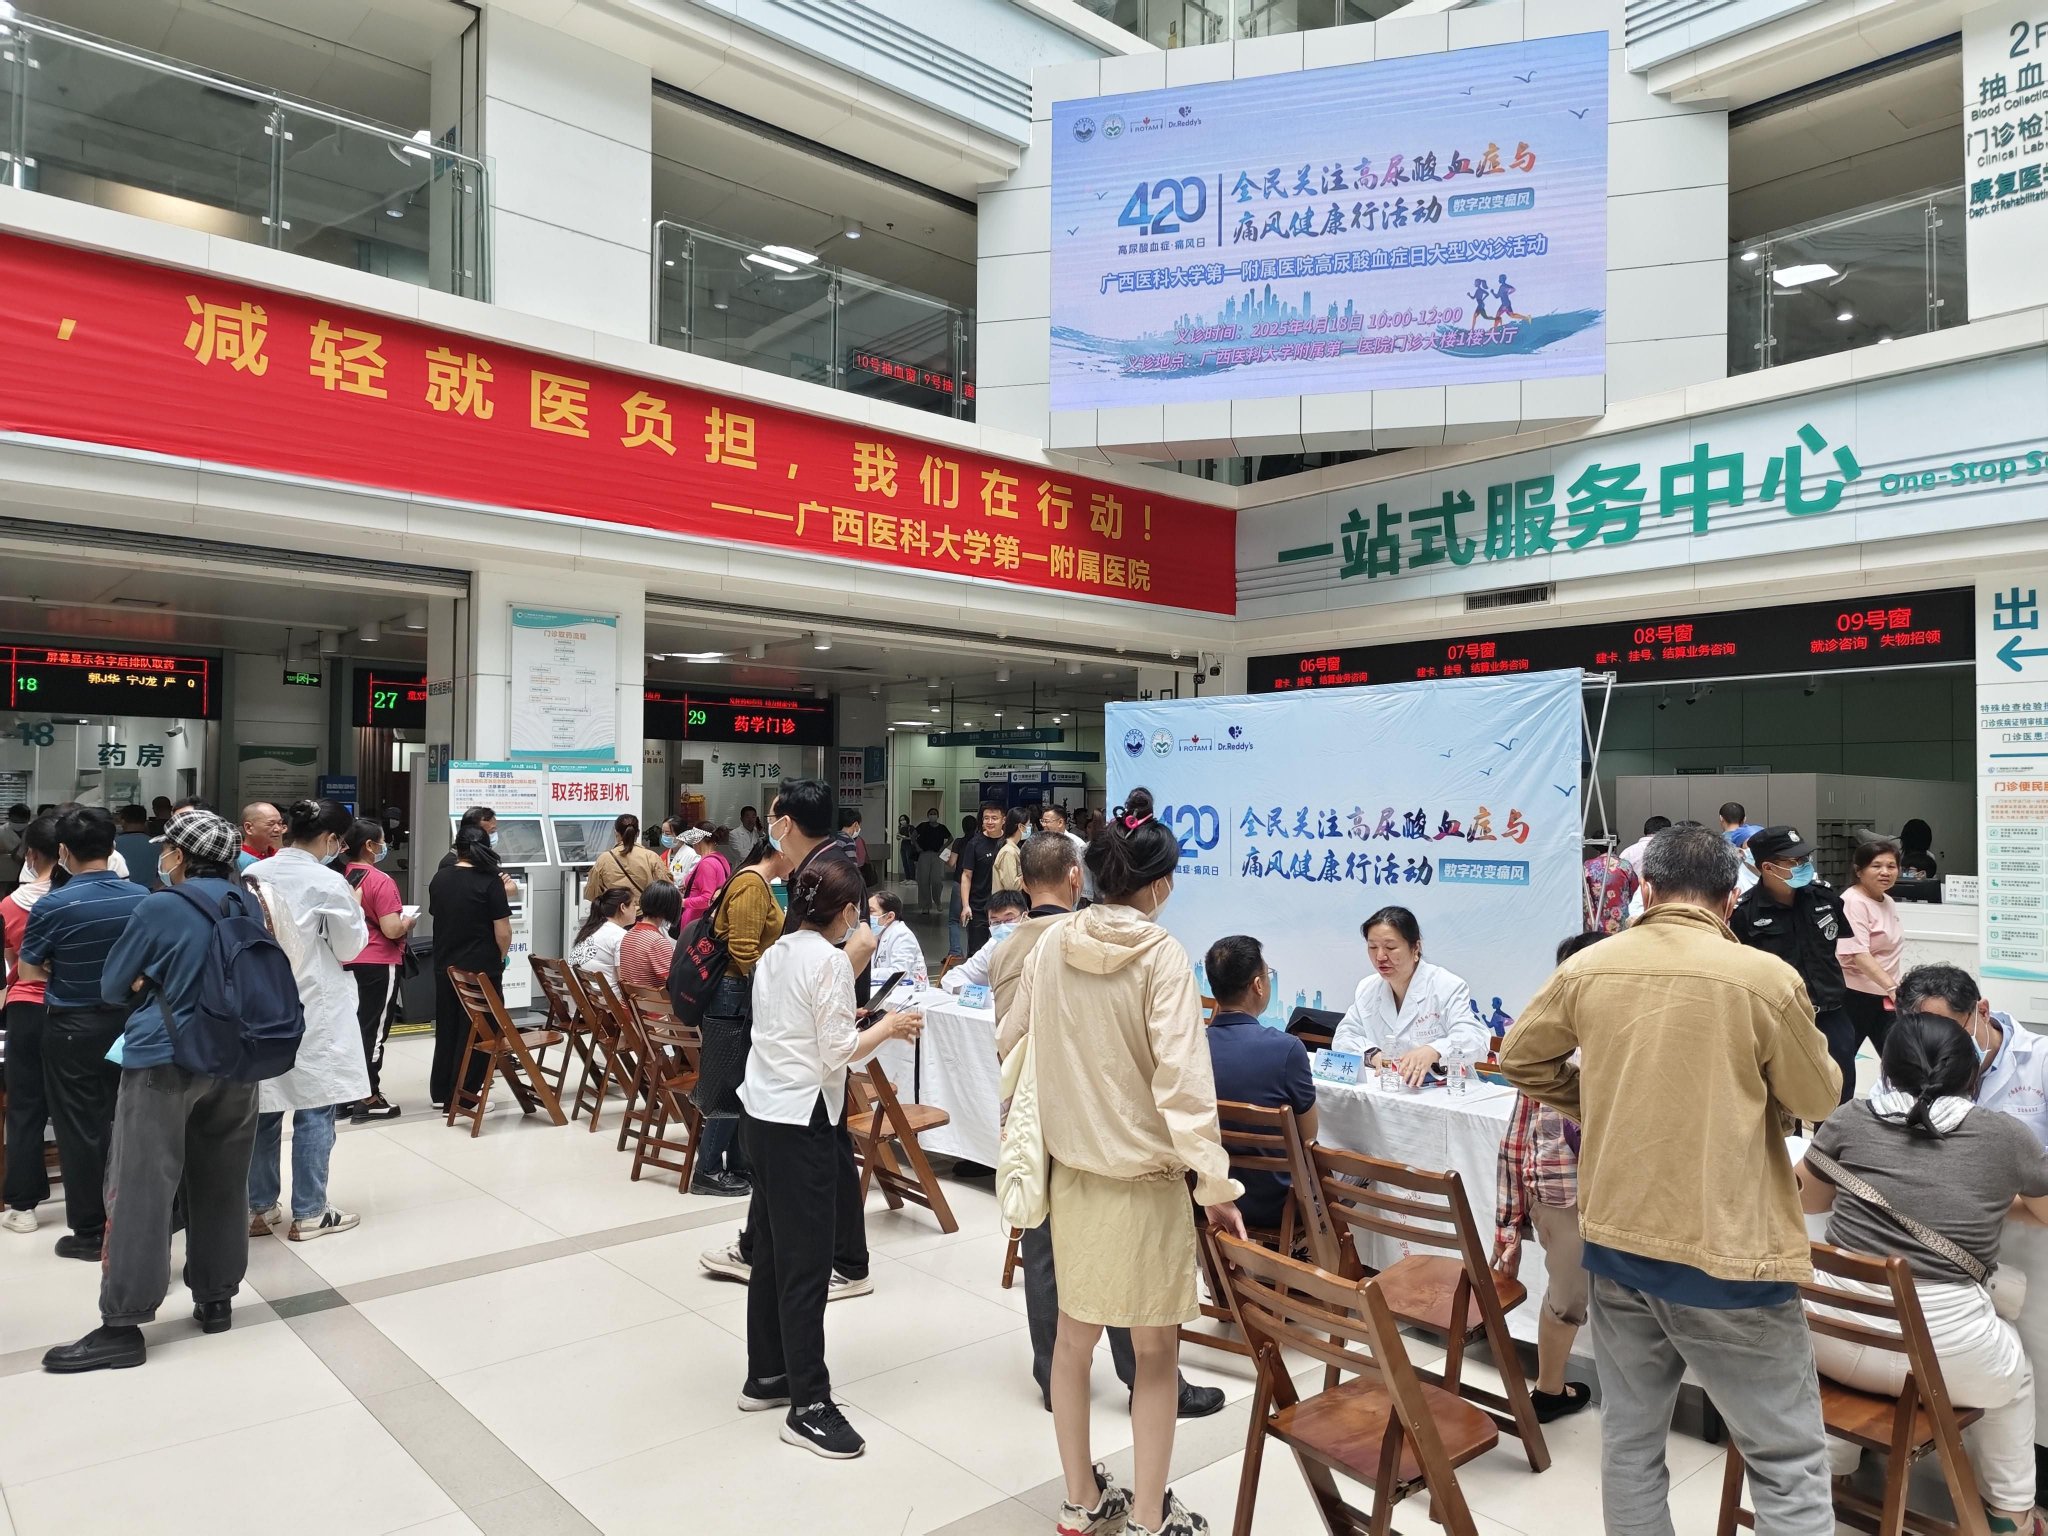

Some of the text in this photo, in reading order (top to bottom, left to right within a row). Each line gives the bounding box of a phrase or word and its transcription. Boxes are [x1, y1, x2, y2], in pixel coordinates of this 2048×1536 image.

[1971, 104, 2000, 121] Blood
[1134, 125, 1159, 133] ROTAM
[1967, 111, 2048, 156] 门诊检
[1977, 140, 2048, 168] Clinical Lab
[1231, 141, 1536, 203] 全民关注高尿酸血症与
[1117, 176, 1207, 237] 420
[1453, 191, 1530, 213] 数字改变痛风
[1968, 204, 1990, 219] Dept.
[1991, 201, 2001, 213] of
[1233, 195, 1443, 244] 痛风健康行活动
[1100, 233, 1549, 295] 广西医科大学第一附属医院高尿酸血症日大型义诊活动
[1368, 307, 1463, 330] 10:00-12:00
[856, 353, 976, 399] 10号抽血窗 9号抽窗
[1880, 450, 2048, 497] One-Stop S
[1278, 423, 1862, 580] 一站式服务中心
[1837, 608, 1912, 632] 09号窗
[1993, 587, 2039, 631] 出
[1634, 624, 1694, 645] 08号窗
[1810, 630, 1941, 654] 就诊咨询 失物招领
[46, 651, 176, 670] 屏幕显示名字后排队取药
[1447, 642, 1496, 660] 07号窗
[1300, 656, 1341, 673] 06号窗
[17, 676, 38, 692] 18
[374, 691, 398, 709] 27
[688, 710, 707, 725] 29
[734, 715, 796, 735] 药学门诊
[17, 721, 54, 747] 18
[98, 743, 164, 767] 药房
[1217, 742, 1253, 752] Dr.Reddy's
[722, 762, 781, 778] 药学门诊
[551, 782, 630, 802] 取药报到机
[1239, 805, 1531, 845] 全民关注高尿酸血症与
[1241, 845, 1434, 886] 痛风健康行活动
[1443, 862, 1525, 882] 数字改变痛风
[1320, 1057, 1354, 1075] 李林
